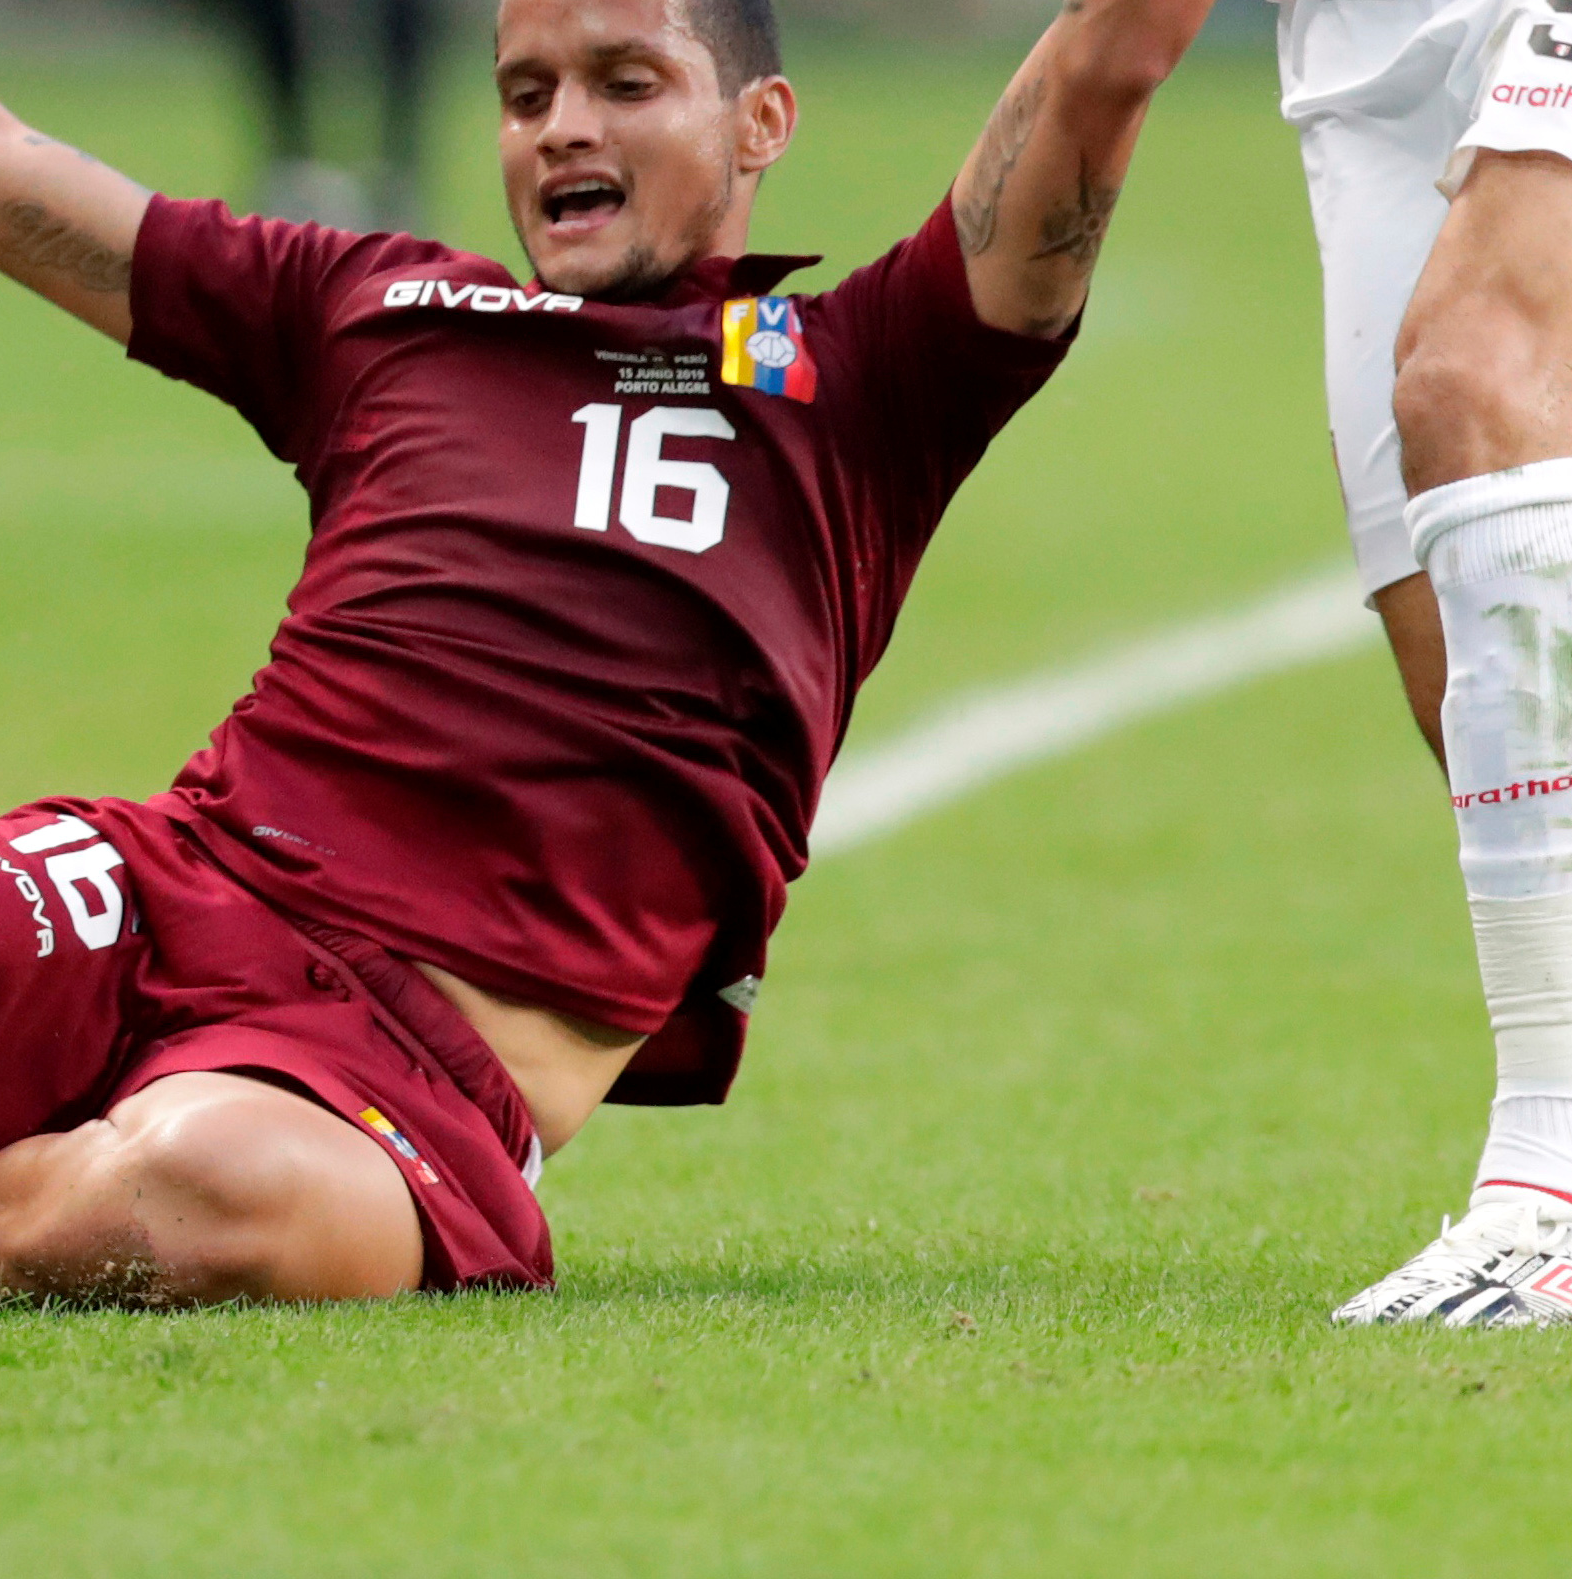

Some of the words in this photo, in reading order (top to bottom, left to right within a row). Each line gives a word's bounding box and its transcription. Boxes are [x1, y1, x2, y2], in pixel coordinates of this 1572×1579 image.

[383, 280, 584, 313] GIVOVA
[614, 380, 660, 394] PORTO
[660, 381, 711, 395] ALEGRE
[635, 368, 674, 381] JUNIO
[676, 368, 705, 381] 2019
[571, 402, 736, 554] 16
[8, 813, 125, 951] 16
